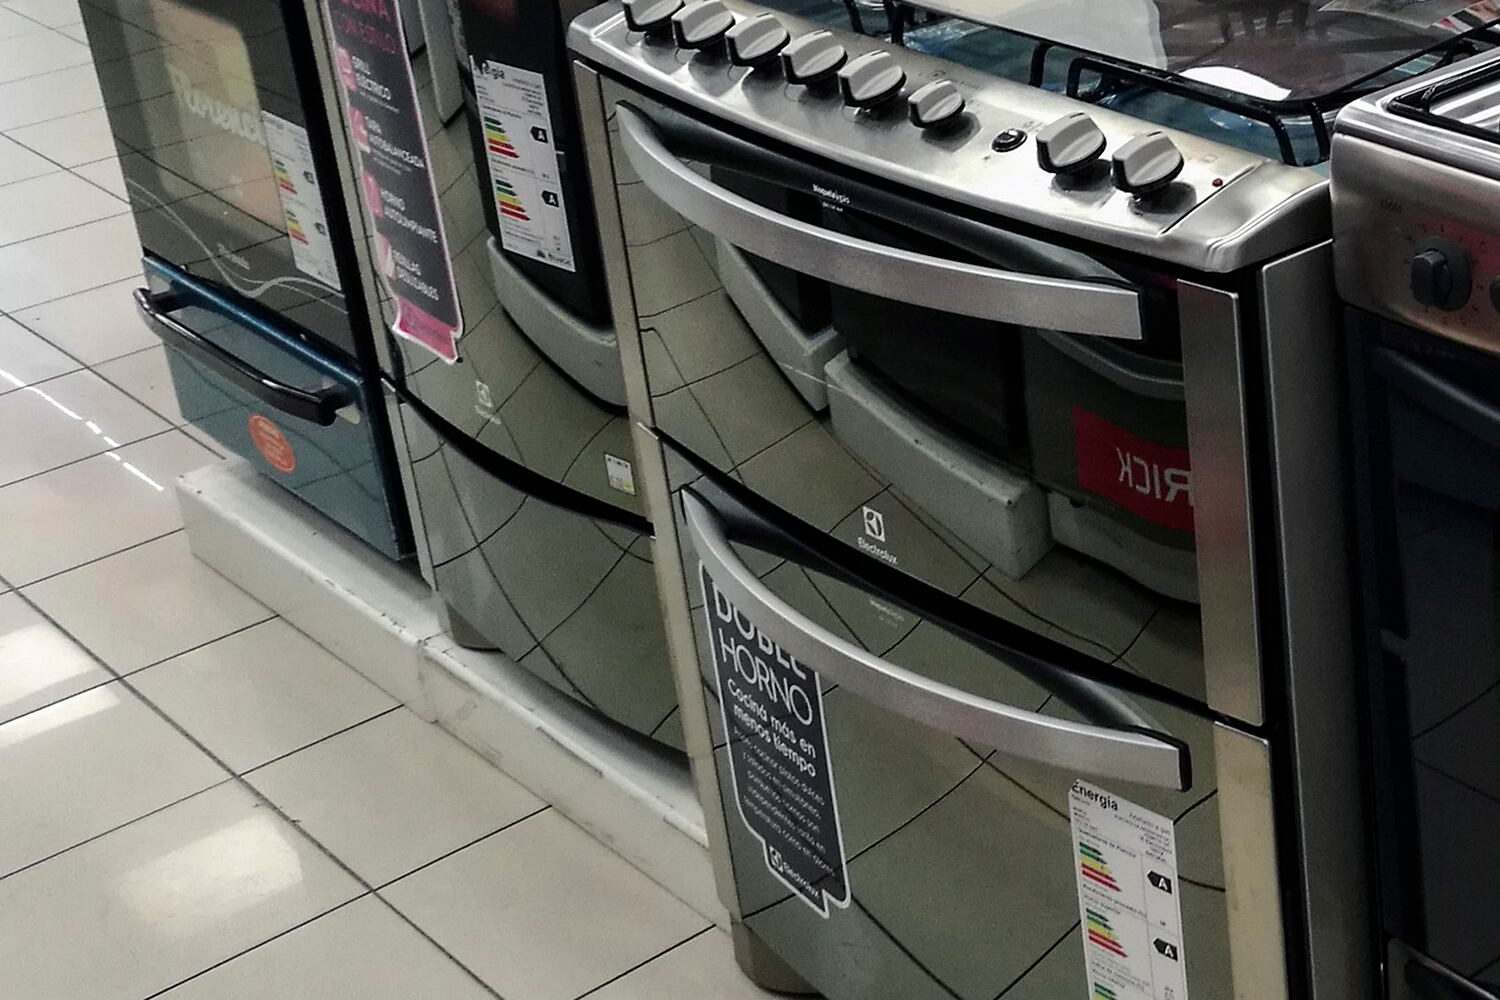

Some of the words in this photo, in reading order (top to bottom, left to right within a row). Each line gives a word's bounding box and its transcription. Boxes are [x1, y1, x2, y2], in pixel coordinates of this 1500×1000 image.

[718, 627, 813, 726] HORNO
[728, 678, 768, 723] Cociná
[770, 715, 797, 744] más
[799, 738, 816, 759] en
[734, 704, 771, 743] menos
[773, 732, 816, 777] tiempo
[1072, 780, 1119, 812] Energía
[1158, 876, 1168, 891] A
[1164, 944, 1174, 957] A
